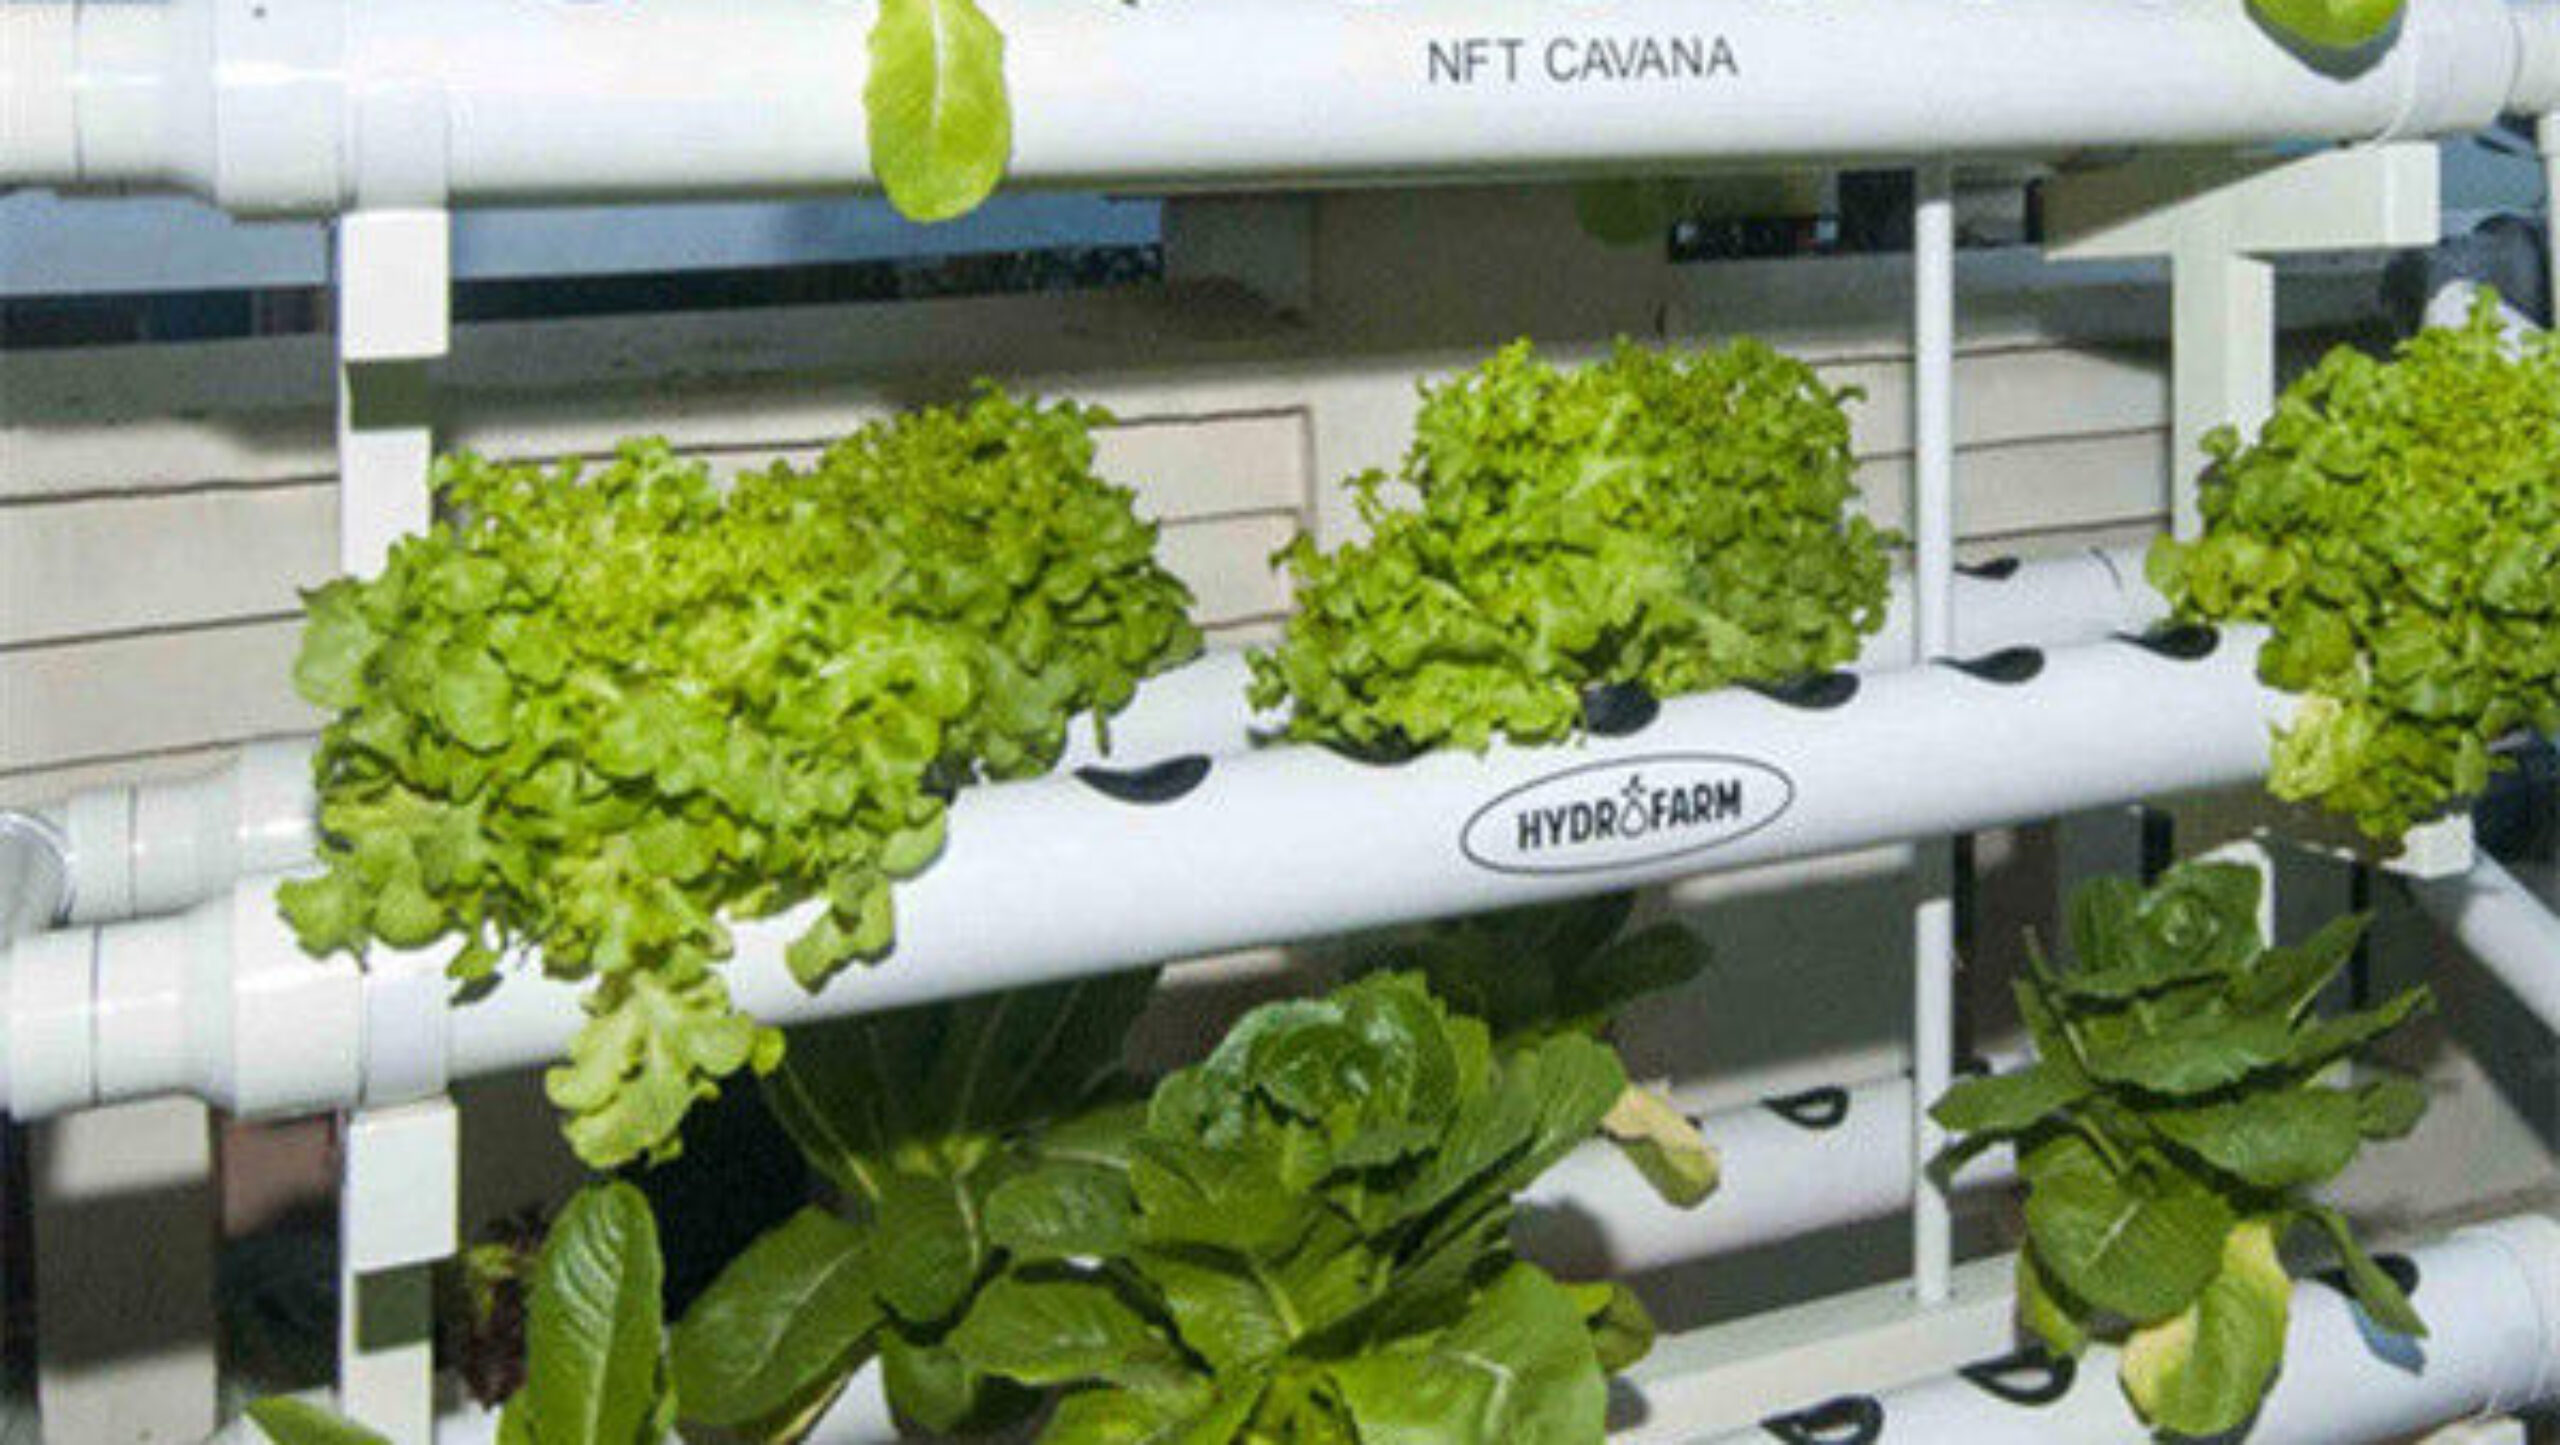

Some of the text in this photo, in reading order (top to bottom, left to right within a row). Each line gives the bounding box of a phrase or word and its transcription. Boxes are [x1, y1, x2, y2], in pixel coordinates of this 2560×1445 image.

[1428, 35, 1739, 82] NFT CAVANA
[1517, 777, 1742, 850] HYDROFARM
